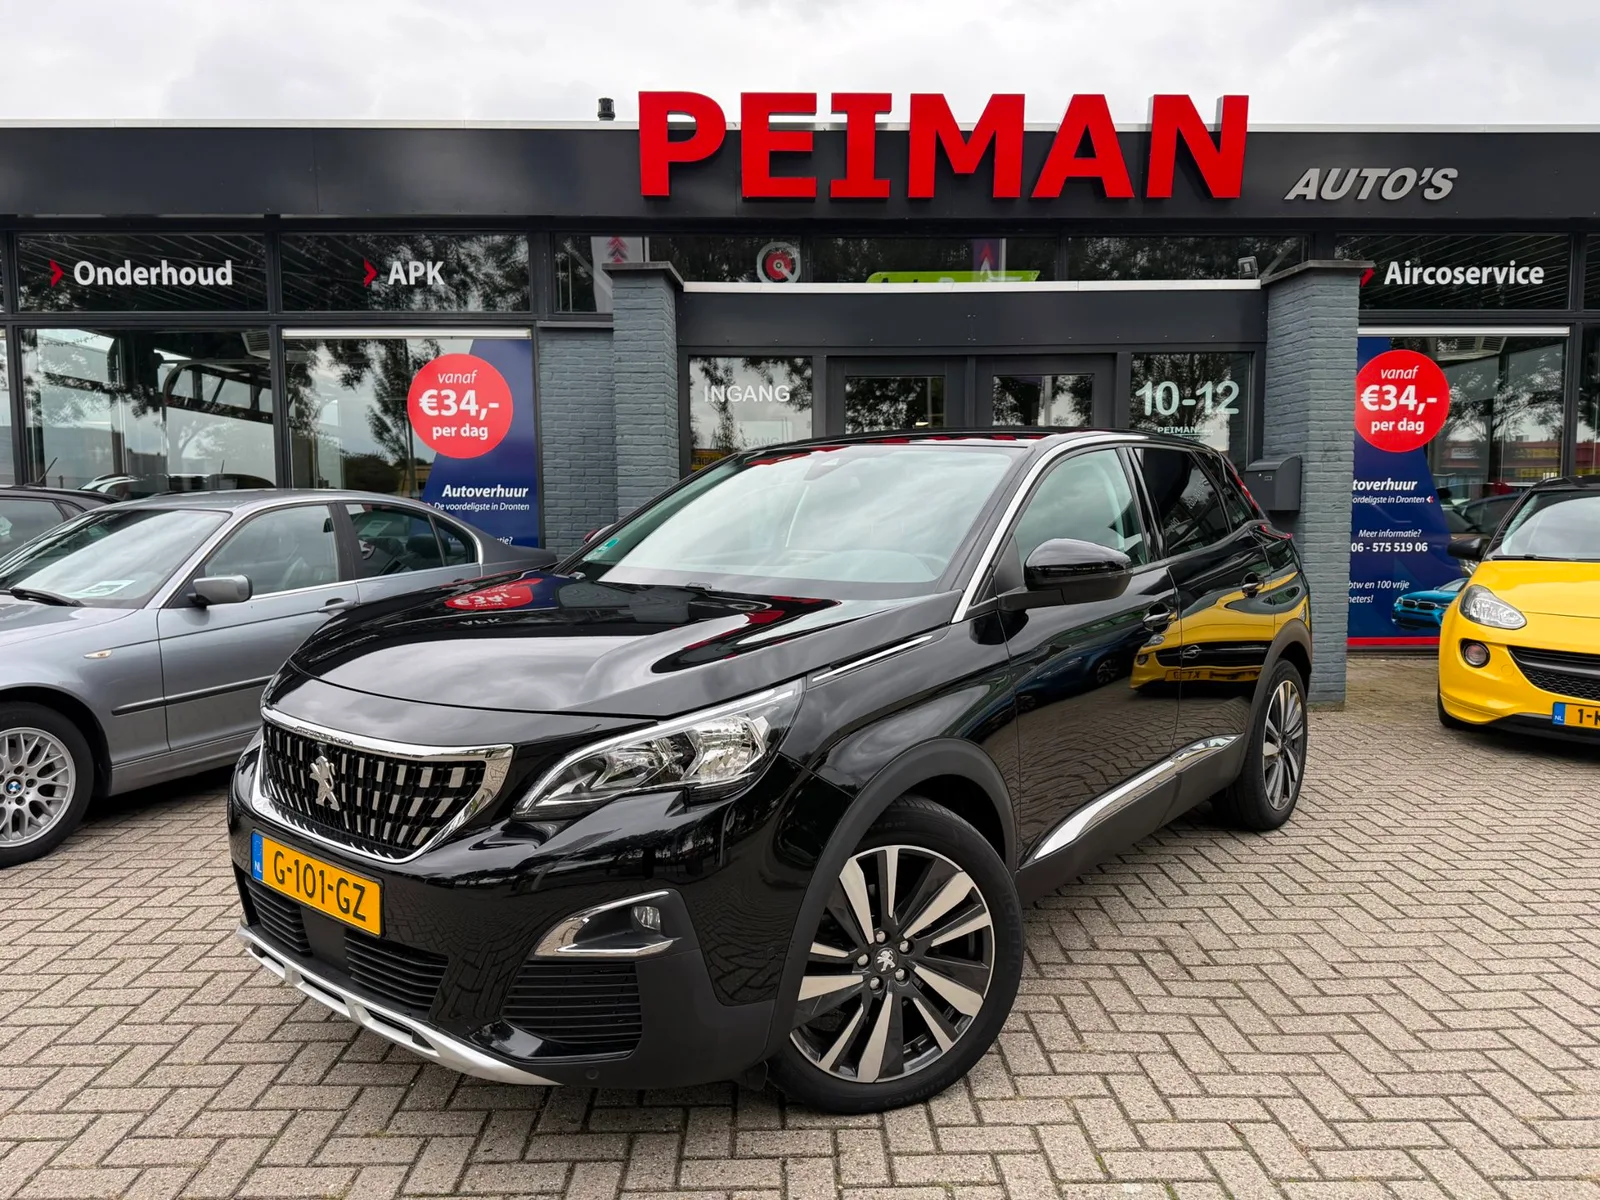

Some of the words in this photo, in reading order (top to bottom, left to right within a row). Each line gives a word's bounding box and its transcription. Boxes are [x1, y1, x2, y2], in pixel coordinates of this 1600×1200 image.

[637, 91, 1249, 199] PEIMAN
[1284, 167, 1458, 201] AUTO'S
[73, 260, 234, 286] Onderhoud
[388, 261, 445, 285] APK
[1383, 260, 1545, 286] Aircoservice
[437, 369, 478, 384] vanaf
[1380, 366, 1419, 380] vanaf
[703, 384, 790, 402] INGANG
[1135, 380, 1240, 416] 10-12
[1360, 384, 1438, 416] €34,-
[418, 388, 500, 421] €34,-
[432, 425, 458, 440] per
[460, 422, 489, 441] dag
[1157, 426, 1197, 434] PEIMAN
[1370, 420, 1396, 435] per
[1397, 417, 1425, 435] dag
[441, 484, 529, 498] Autoverhuur
[1352, 477, 1418, 491] toverhuur
[433, 502, 445, 511] De
[445, 502, 490, 512] voordeligste
[490, 502, 499, 511] in
[499, 502, 530, 511] Dronten
[1352, 495, 1387, 506] ordeligste
[1388, 495, 1395, 504] in
[1395, 495, 1425, 504] Dronten
[1358, 529, 1377, 538] Meer
[1378, 529, 1422, 538] informatie?
[1351, 542, 1364, 552] 06
[1372, 542, 1392, 552] 575
[1393, 542, 1413, 552] 519
[1415, 542, 1428, 552] 06
[1377, 580, 1392, 589] 100
[1392, 580, 1410, 591] vrije
[254, 861, 263, 873] NL
[273, 850, 367, 922] G-101-GZ
